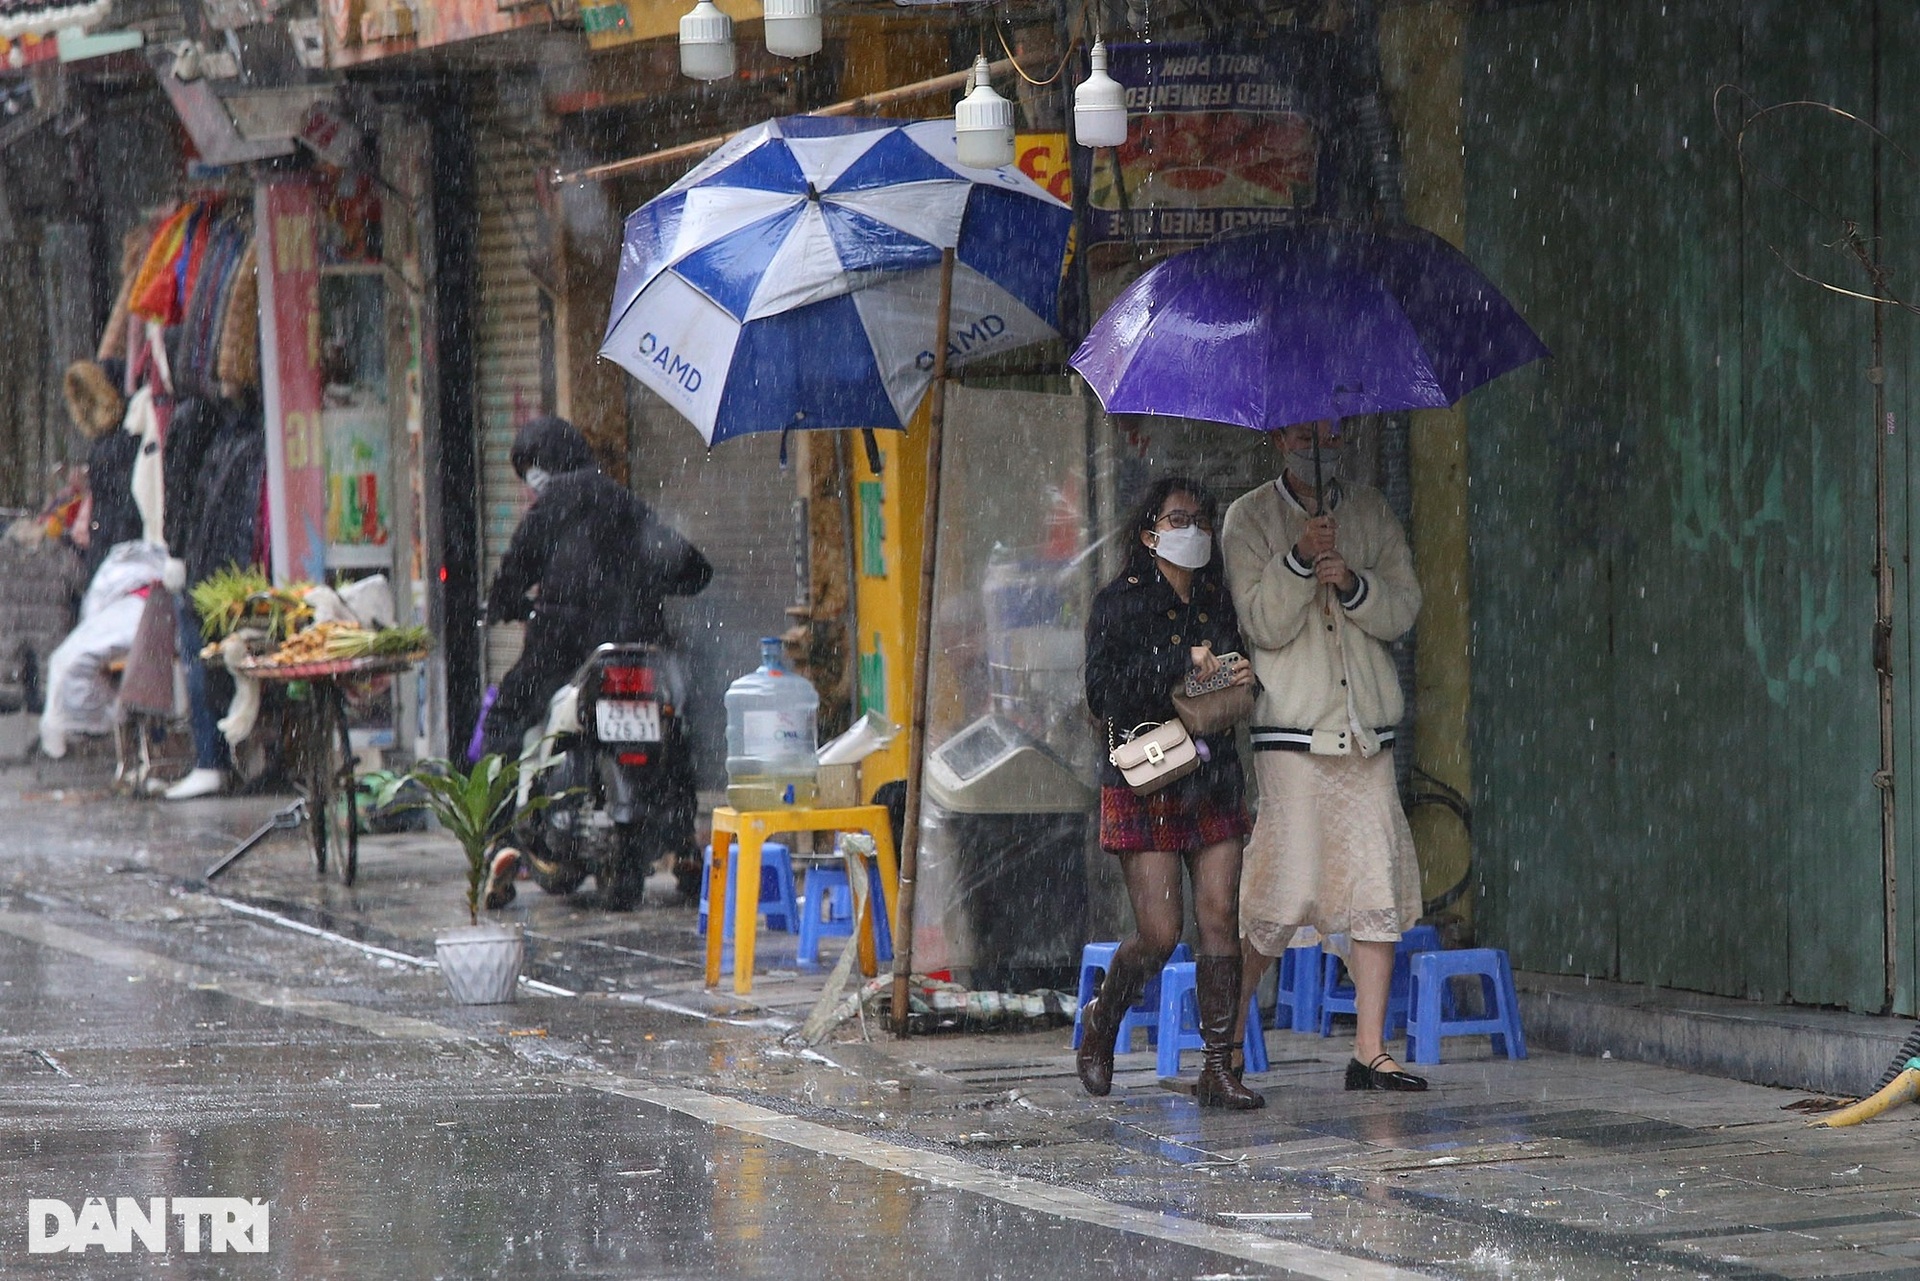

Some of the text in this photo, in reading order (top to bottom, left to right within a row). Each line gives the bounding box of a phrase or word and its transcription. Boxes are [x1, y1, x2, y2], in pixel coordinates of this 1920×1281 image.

[1160, 55, 1212, 77] PORK
[1126, 83, 1232, 108] FERMENTED
[1108, 212, 1157, 236] RIE
[1160, 211, 1216, 234] FRIED
